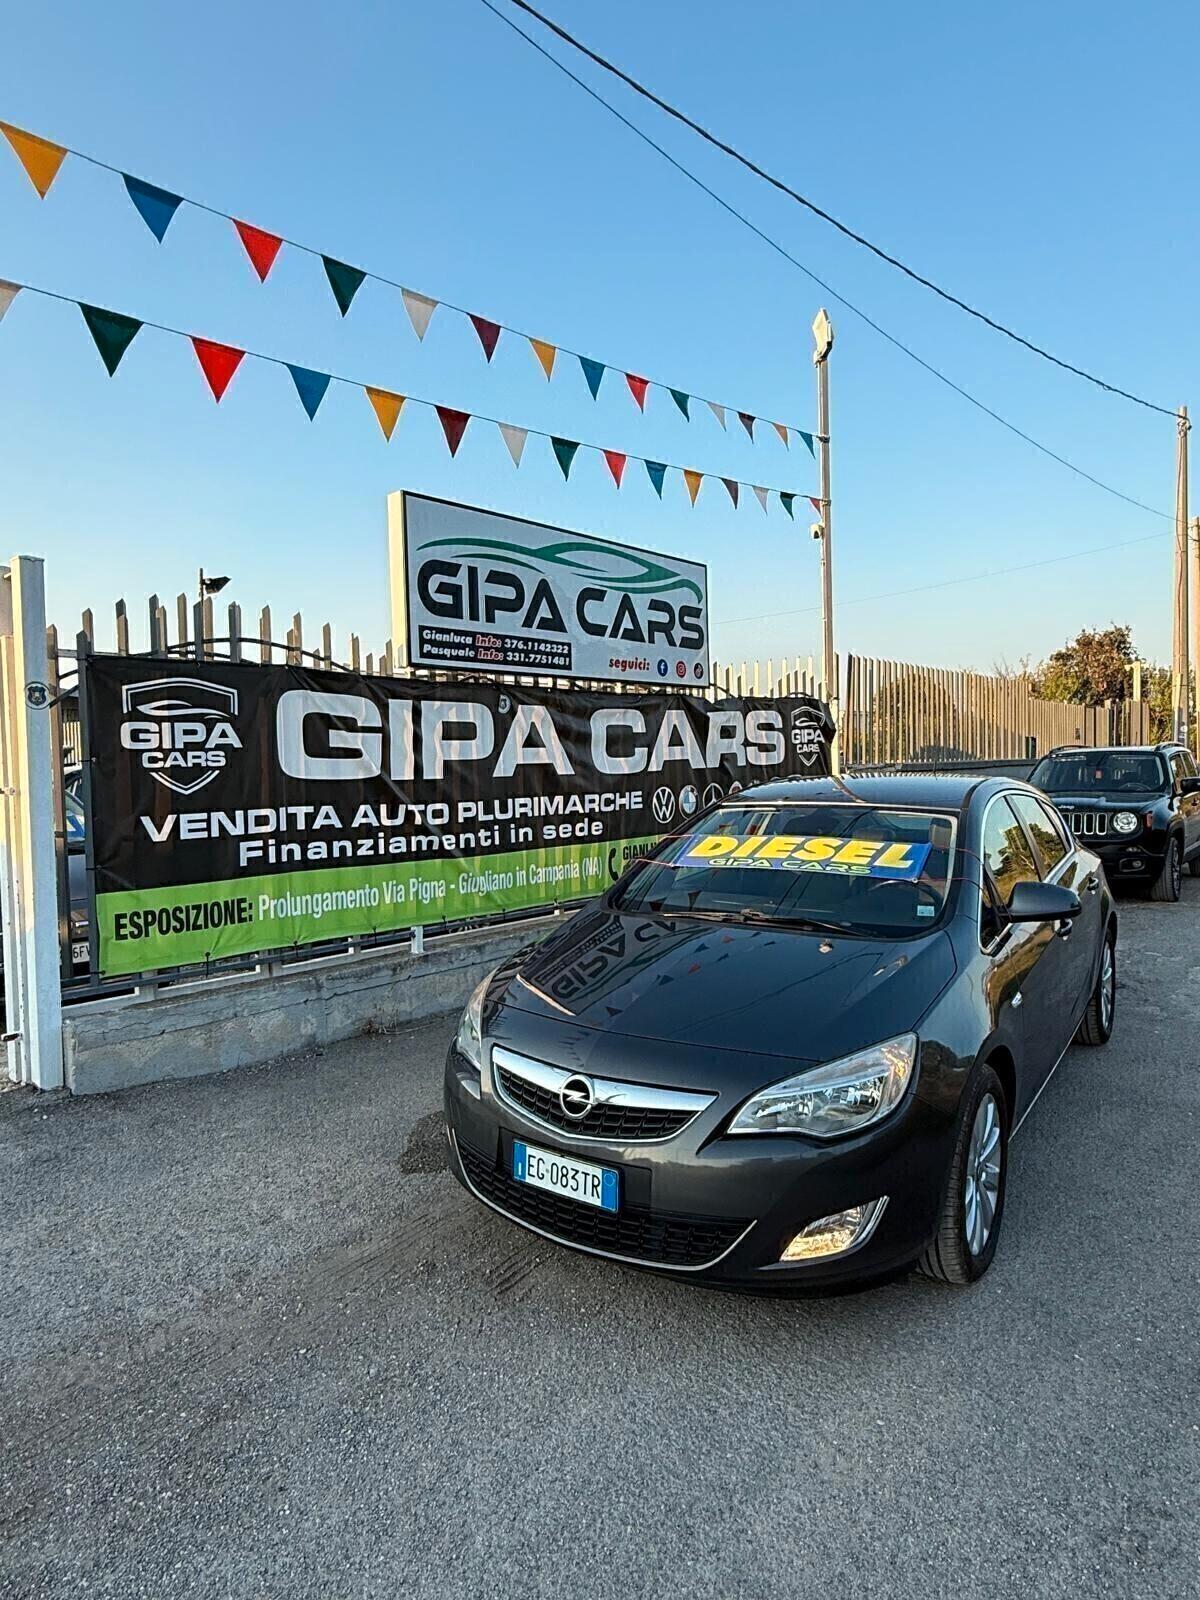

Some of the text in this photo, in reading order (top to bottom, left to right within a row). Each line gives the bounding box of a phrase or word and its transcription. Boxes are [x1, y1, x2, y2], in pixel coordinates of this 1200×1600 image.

[417, 559, 705, 650] GIPA CARS
[422, 629, 473, 645] Gianluca
[423, 643, 475, 658] Pasquale
[608, 656, 650, 672] seguici:
[120, 720, 243, 750] GIPA
[277, 689, 786, 781] GIPA CARS
[791, 728, 825, 744] GIPA
[142, 750, 226, 769] CARS
[796, 743, 820, 753] CARS
[140, 790, 644, 843] VENDITA AUTO PLURIMARCHE
[239, 817, 604, 867] Finanziamenti in sede
[687, 835, 916, 869] DIESEL
[707, 857, 873, 875] GIPA CARS
[114, 897, 253, 942] ESPOSIZIONE:
[258, 883, 379, 921] Prolungamento
[382, 879, 406, 905] Via
[409, 877, 447, 905] Pigna
[458, 868, 513, 897] Giugliano
[516, 866, 527, 887] in
[529, 860, 580, 887] Campania
[582, 856, 603, 882] (NA)
